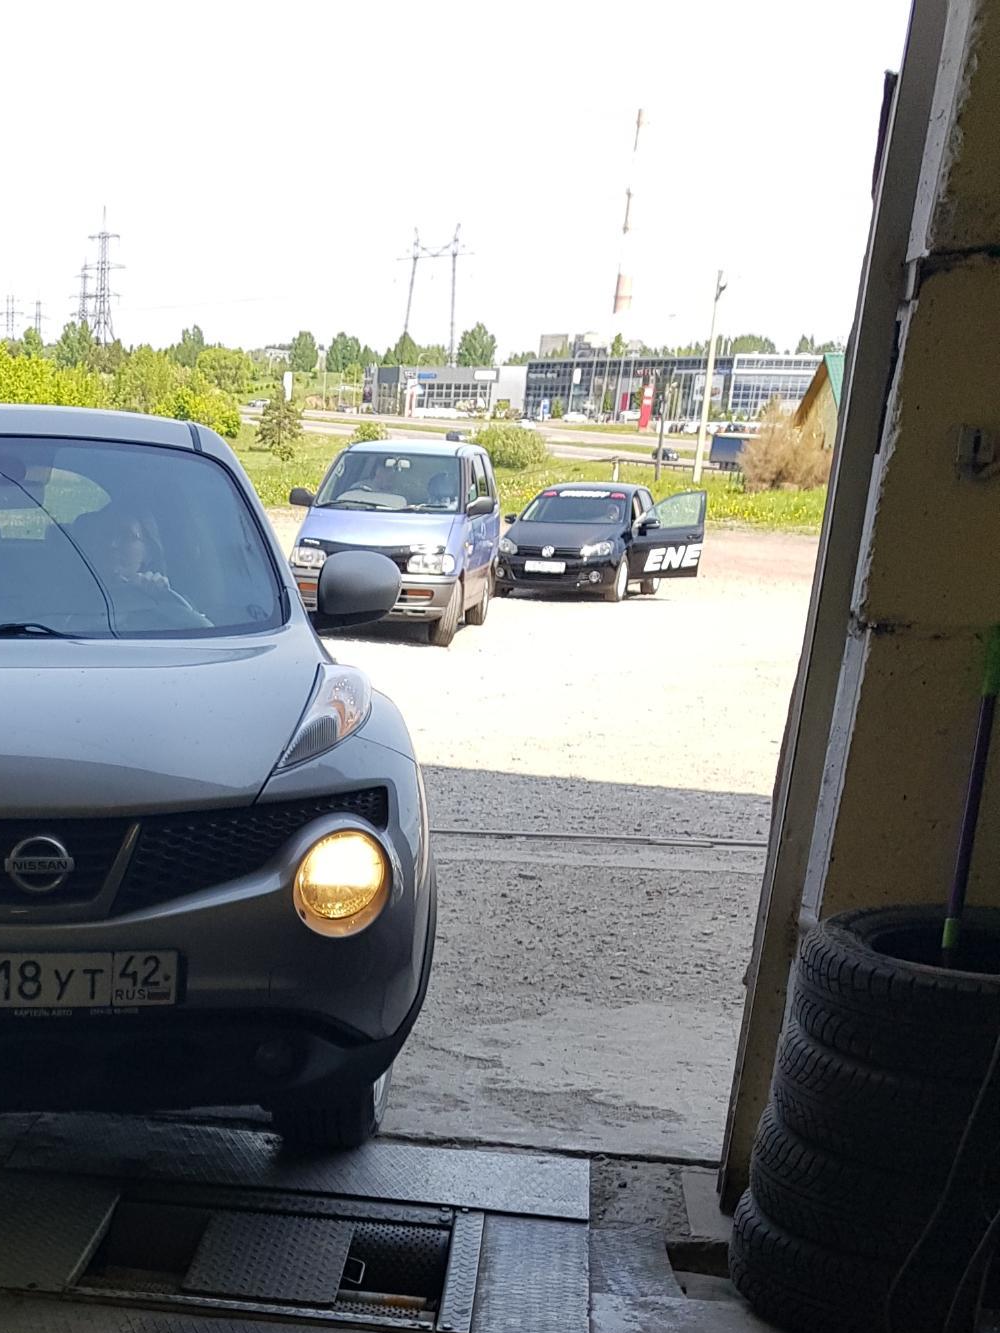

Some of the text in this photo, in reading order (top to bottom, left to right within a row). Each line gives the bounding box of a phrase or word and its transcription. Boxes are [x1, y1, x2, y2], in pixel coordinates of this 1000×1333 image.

[12, 860, 68, 871] NISSAN
[119, 955, 161, 988] 42
[115, 988, 146, 1001] RUS
